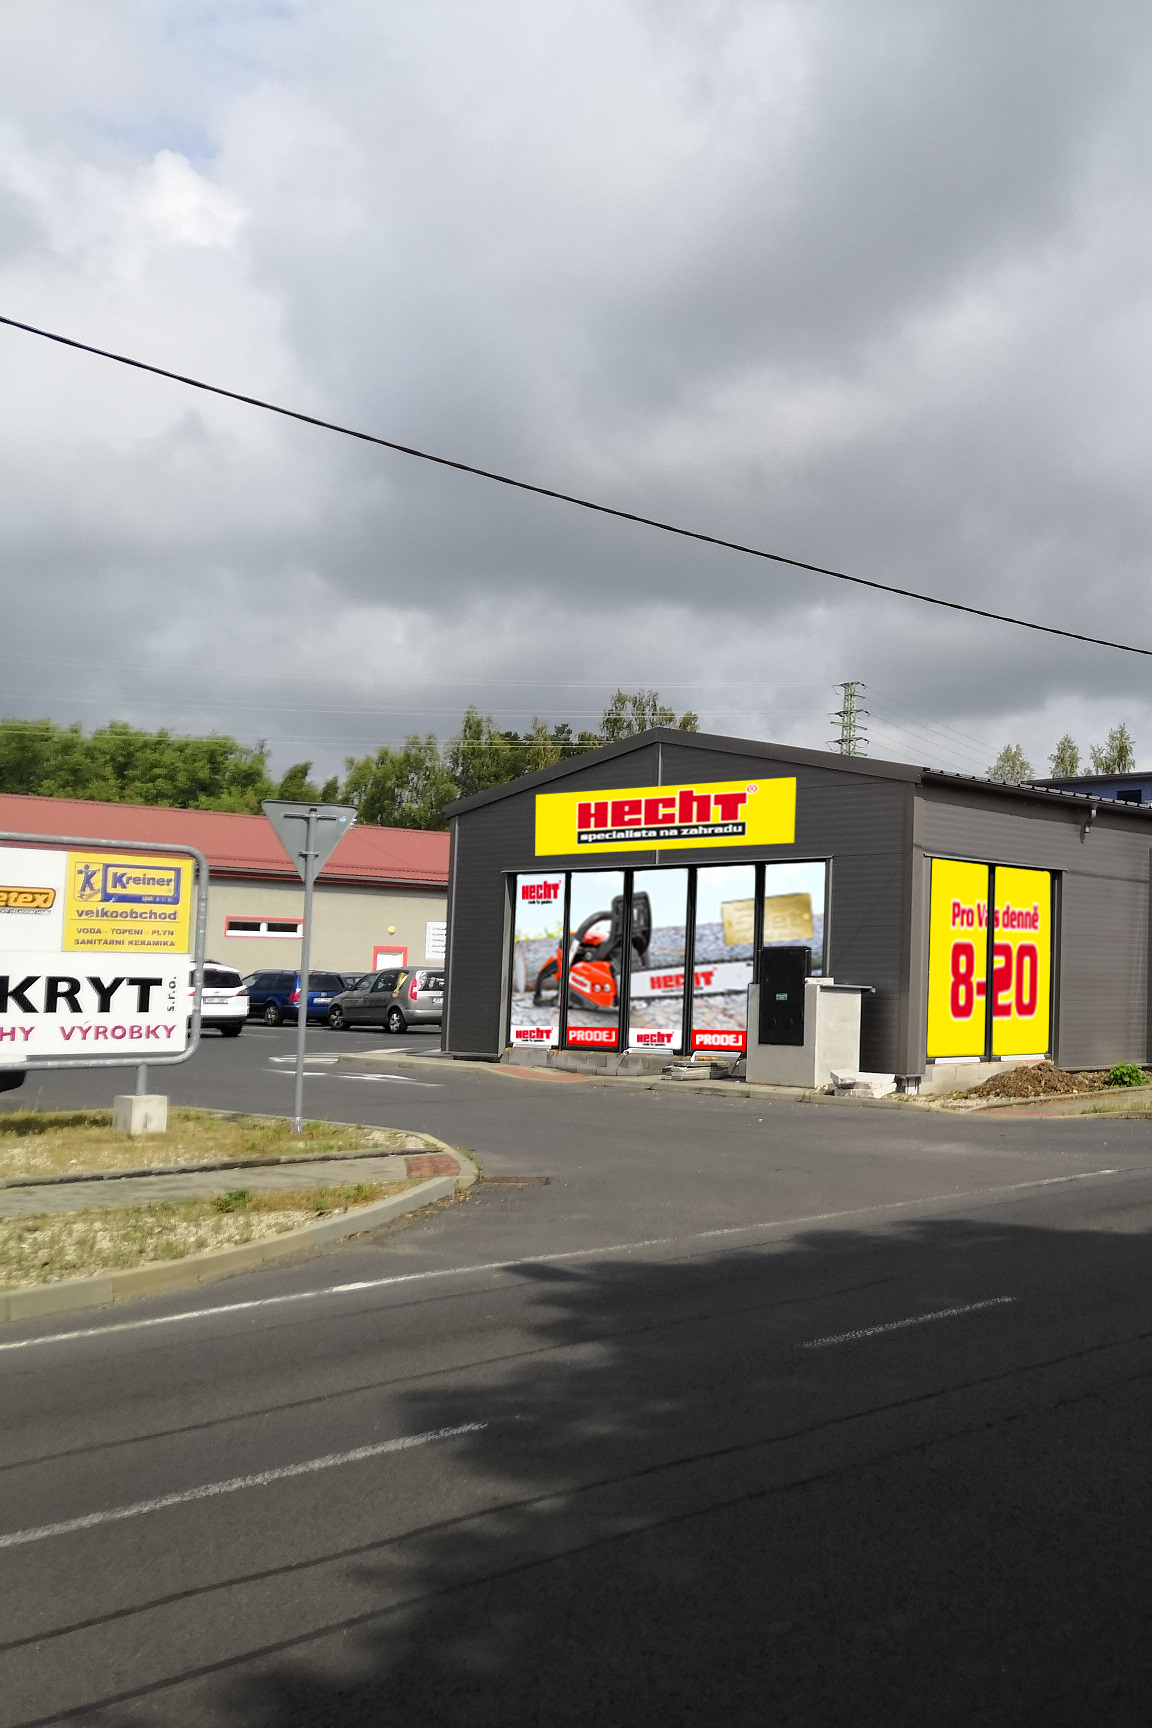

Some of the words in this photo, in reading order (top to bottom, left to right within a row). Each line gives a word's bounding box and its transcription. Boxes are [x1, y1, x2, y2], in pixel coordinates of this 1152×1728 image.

[580, 829, 657, 842] specialista
[660, 828, 678, 837] na
[681, 824, 742, 836] zahradu
[111, 871, 172, 889] Kreiner
[76, 907, 178, 921] velkoobchod
[952, 901, 974, 927] Pro
[1002, 904, 1039, 930] denně
[127, 939, 175, 947] KERAMIKA
[950, 942, 1038, 1018] 8-20
[0, 975, 163, 1013] KRYT
[59, 1020, 177, 1041] VÝROBKY
[569, 1031, 616, 1042] PRODEJ
[696, 1034, 743, 1046] PRODEJ
